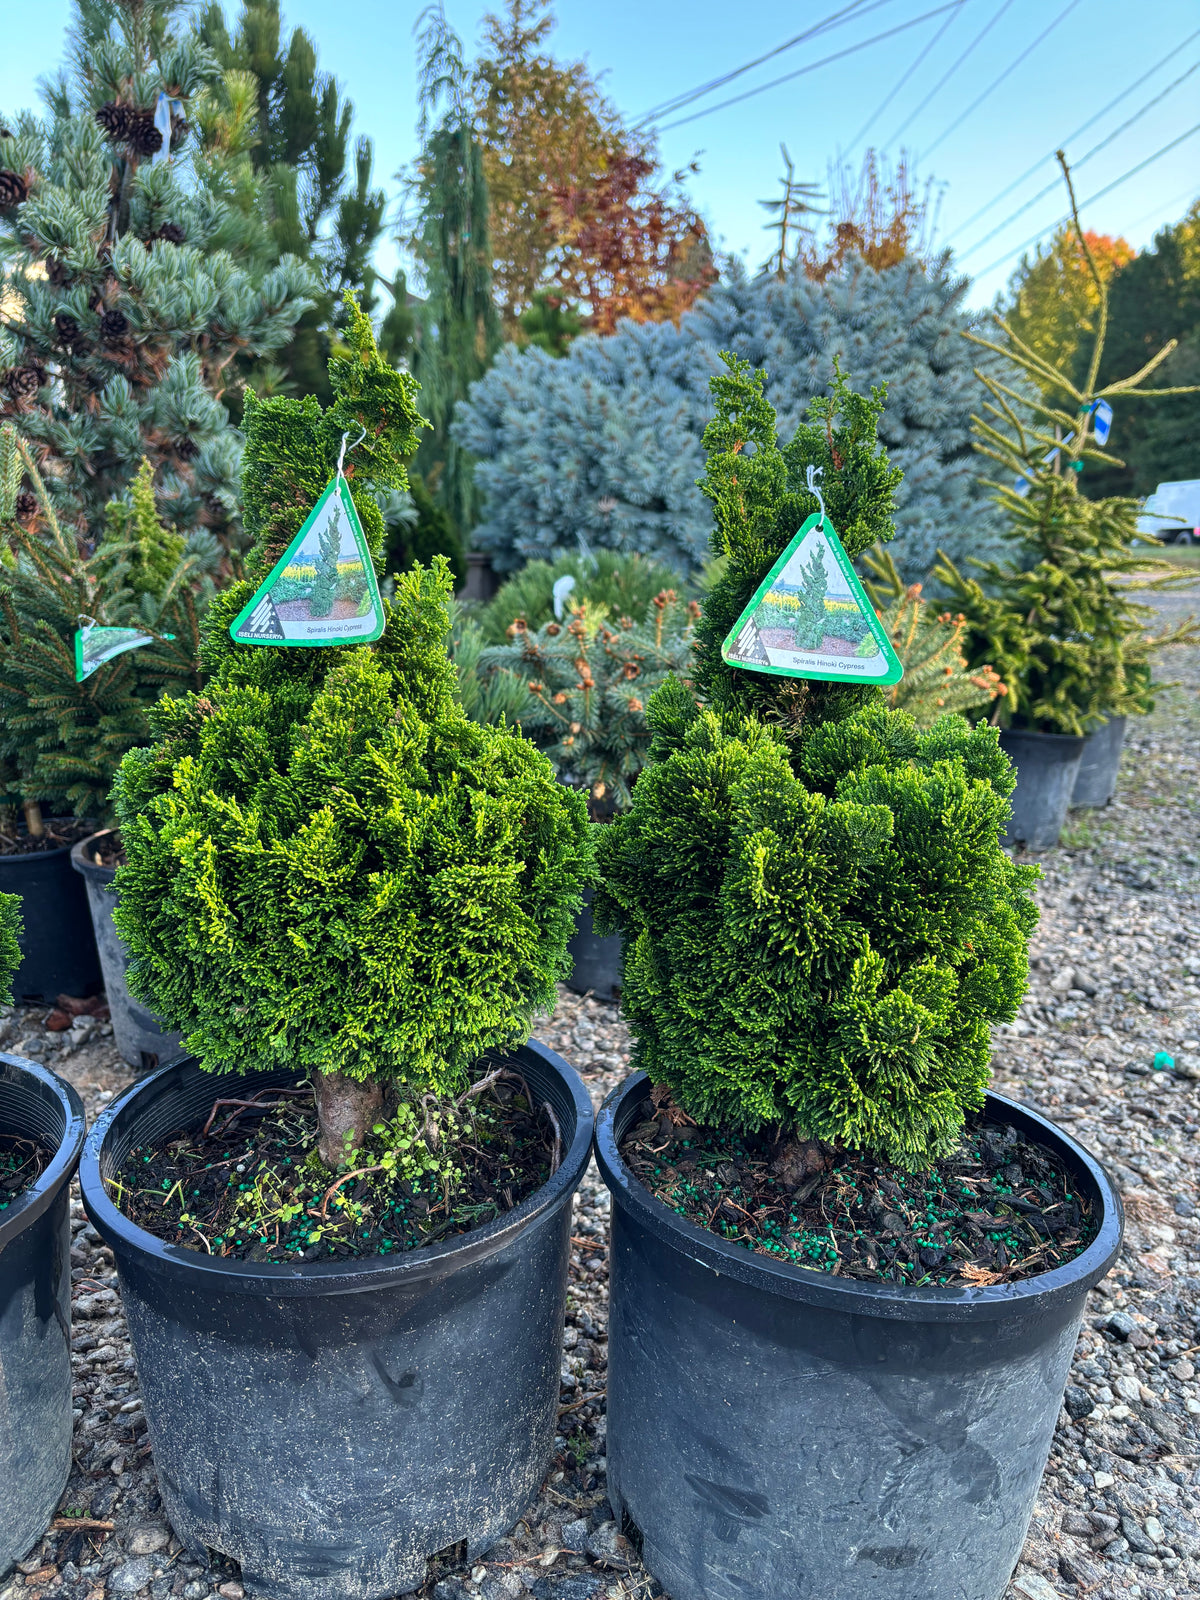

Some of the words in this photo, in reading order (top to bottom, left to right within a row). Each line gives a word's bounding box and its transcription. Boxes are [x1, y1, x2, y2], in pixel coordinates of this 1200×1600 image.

[307, 626, 327, 634] Spiralis
[343, 623, 362, 632] Cypress
[792, 657, 816, 666] Spiralis
[817, 660, 837, 668] Hinoki
[838, 661, 865, 670] Cypress
